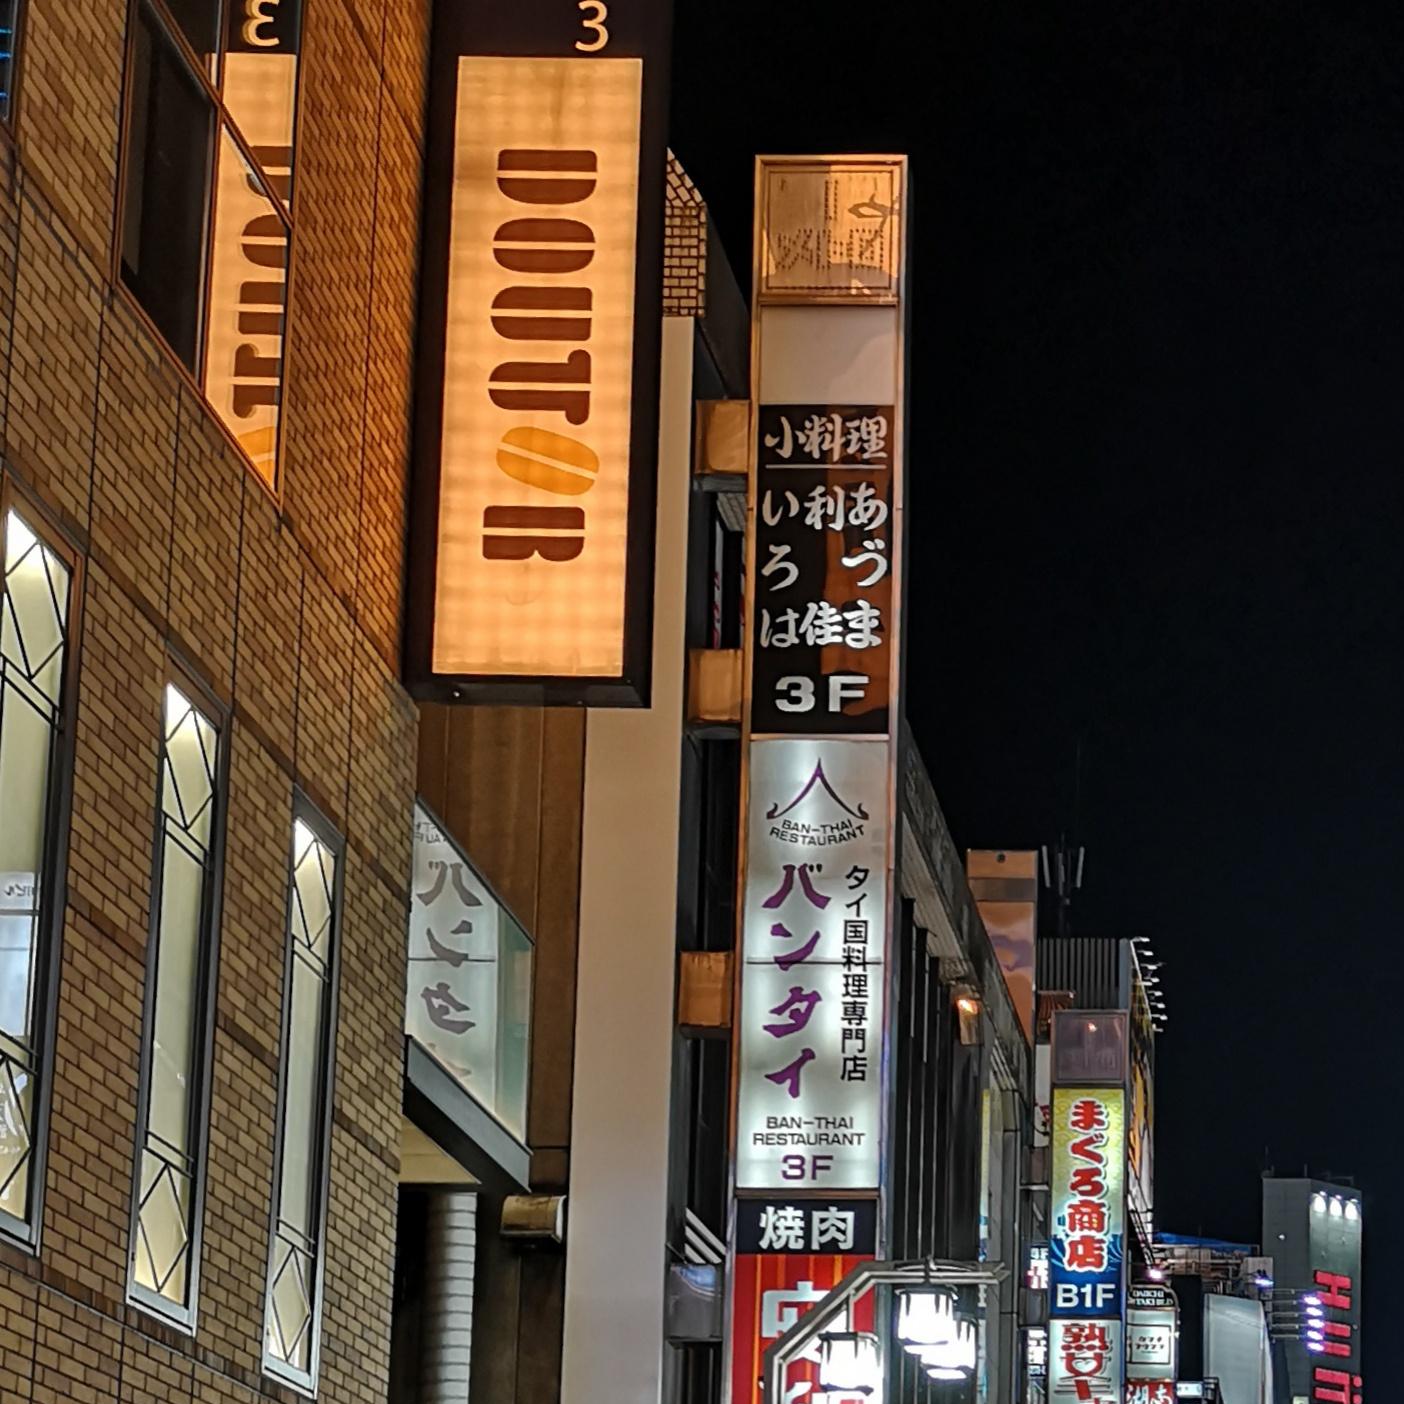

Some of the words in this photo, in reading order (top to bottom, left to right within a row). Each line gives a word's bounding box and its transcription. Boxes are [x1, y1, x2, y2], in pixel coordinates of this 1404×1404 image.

[574, 0, 609, 52] 3
[764, 413, 889, 462] 小料理
[774, 675, 870, 712] 3F
[769, 822, 867, 847] RESTAURANT
[782, 818, 854, 835] BAN-THAI
[762, 862, 832, 1099] バンタイ
[840, 865, 870, 1082] タイ国料理専門店
[753, 1131, 866, 1147] RESTAURANT
[765, 1115, 854, 1131] BAN-THAI
[781, 1154, 834, 1181] 3F
[1065, 1100, 1113, 1273] まぐろ商店
[759, 1206, 856, 1250] 焼肉
[1056, 1281, 1116, 1309] B1F
